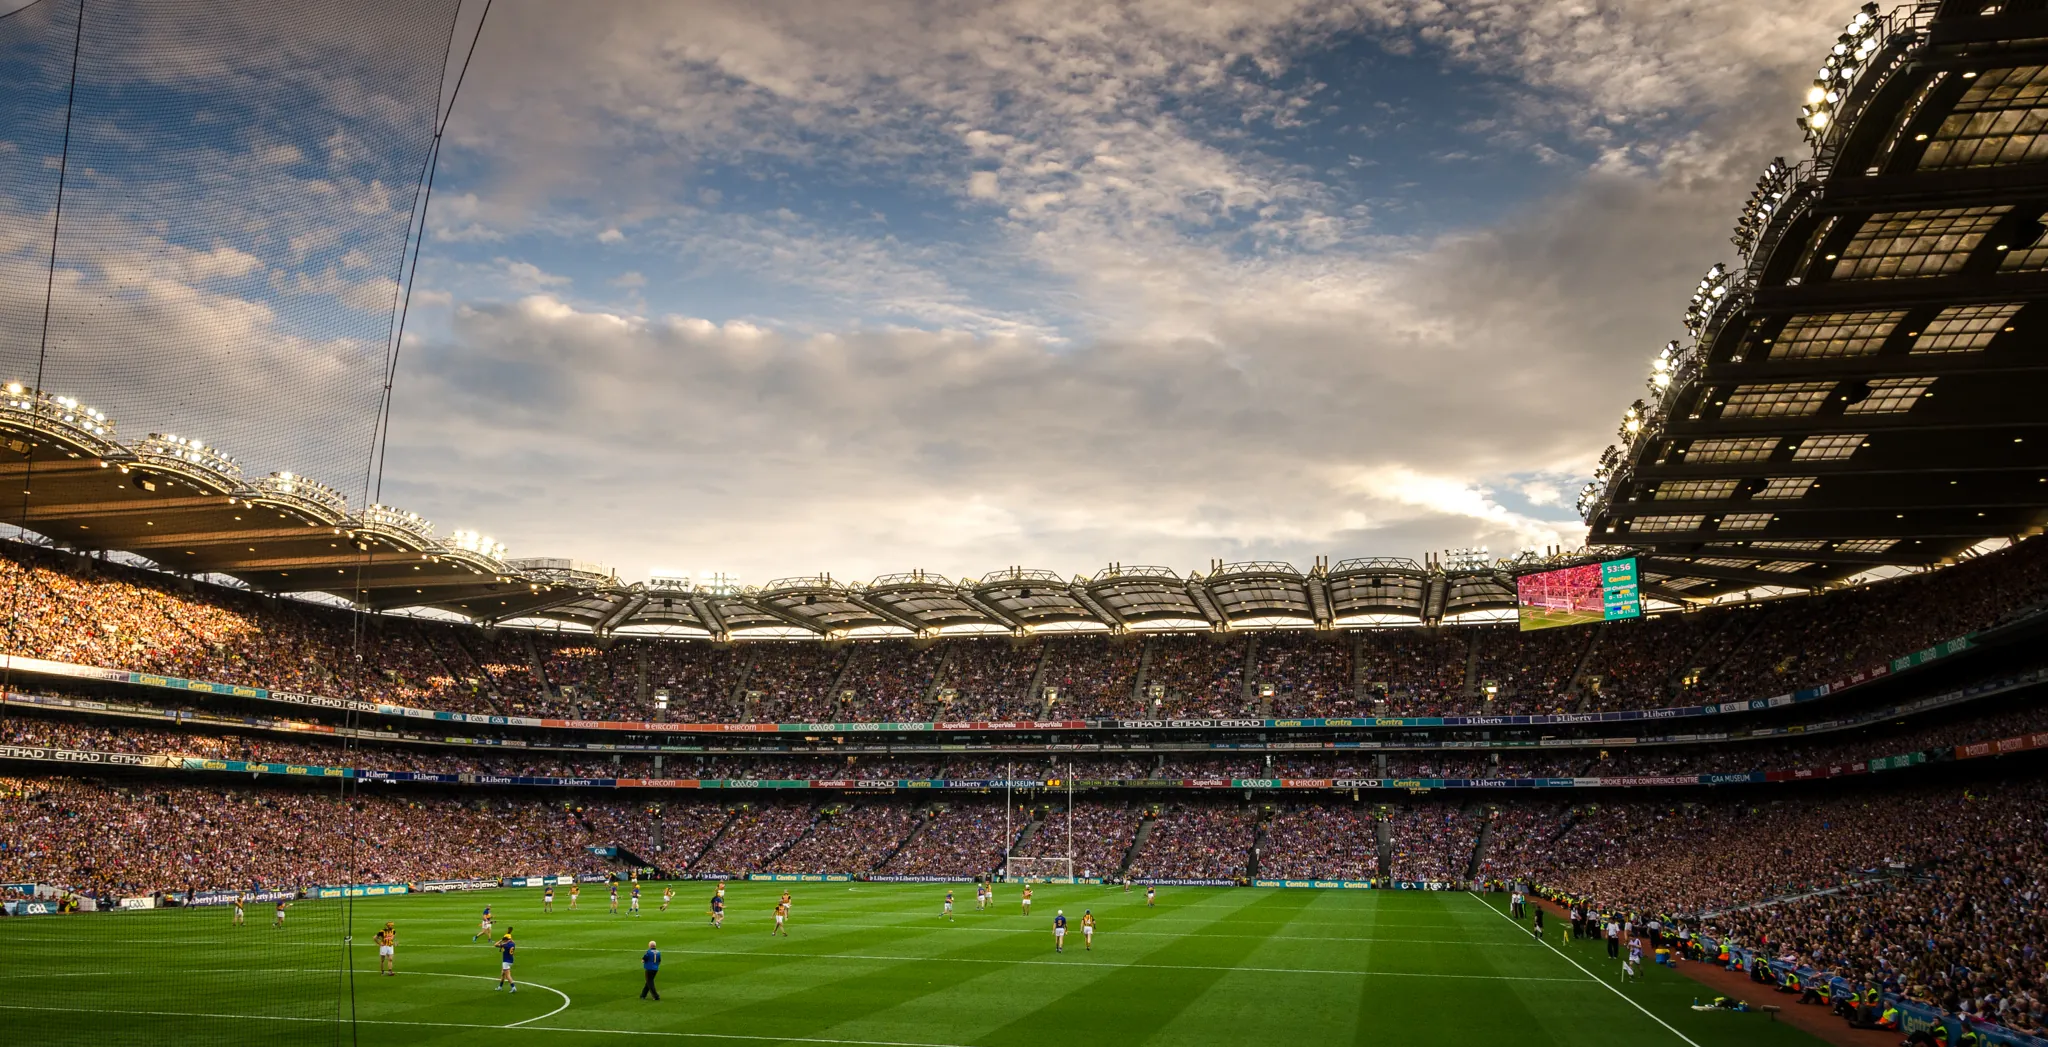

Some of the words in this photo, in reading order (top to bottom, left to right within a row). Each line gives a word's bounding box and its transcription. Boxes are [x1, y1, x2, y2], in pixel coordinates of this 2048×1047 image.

[1607, 563, 1631, 573] 53:56
[139, 674, 167, 686] Centra
[187, 681, 213, 693] Centra
[233, 686, 257, 697] Centra
[272, 693, 304, 703] ETIHAD
[311, 697, 342, 707] ETIHAD
[347, 702, 376, 711] ETHAD
[1752, 700, 1765, 708] GAA
[1648, 709, 1676, 718] Liberty
[1704, 706, 1717, 714] GAA
[491, 716, 505, 724] GAA
[1274, 718, 1302, 727] Centra
[1325, 718, 1352, 726] Centra
[1375, 718, 1403, 726] Centra
[1472, 717, 1503, 725] Liberty
[1561, 714, 1592, 723] Liberty
[571, 720, 599, 728] eircom
[987, 720, 1016, 729] SuperValu
[1033, 720, 1063, 728] SuperValu
[55, 752, 100, 762] ETIHAD
[110, 754, 151, 765] ETIHAD
[202, 759, 227, 769] Centra
[246, 762, 269, 772] Centra
[286, 764, 307, 774] Centra
[369, 770, 389, 779] Liberty
[417, 773, 439, 782] Liberty
[1711, 775, 1724, 783] GAA
[1725, 774, 1750, 783] MUSEUM
[486, 776, 512, 785] Liberty
[564, 778, 591, 786] Liberty
[818, 780, 846, 788] SuperValu
[955, 780, 981, 788] Liberty
[1192, 780, 1222, 788] SuperValu
[1475, 779, 1506, 787] Liberty
[1638, 777, 1675, 785] CONFERENCE
[1676, 776, 1698, 784] CENTRE
[708, 873, 728, 881] Liberty
[1343, 881, 1368, 889] Centra
[366, 887, 385, 895] Centra
[388, 885, 406, 893] Centra
[129, 899, 146, 908] GAA
[27, 903, 48, 914] GAA
[1902, 1009, 1931, 1034] Centr
